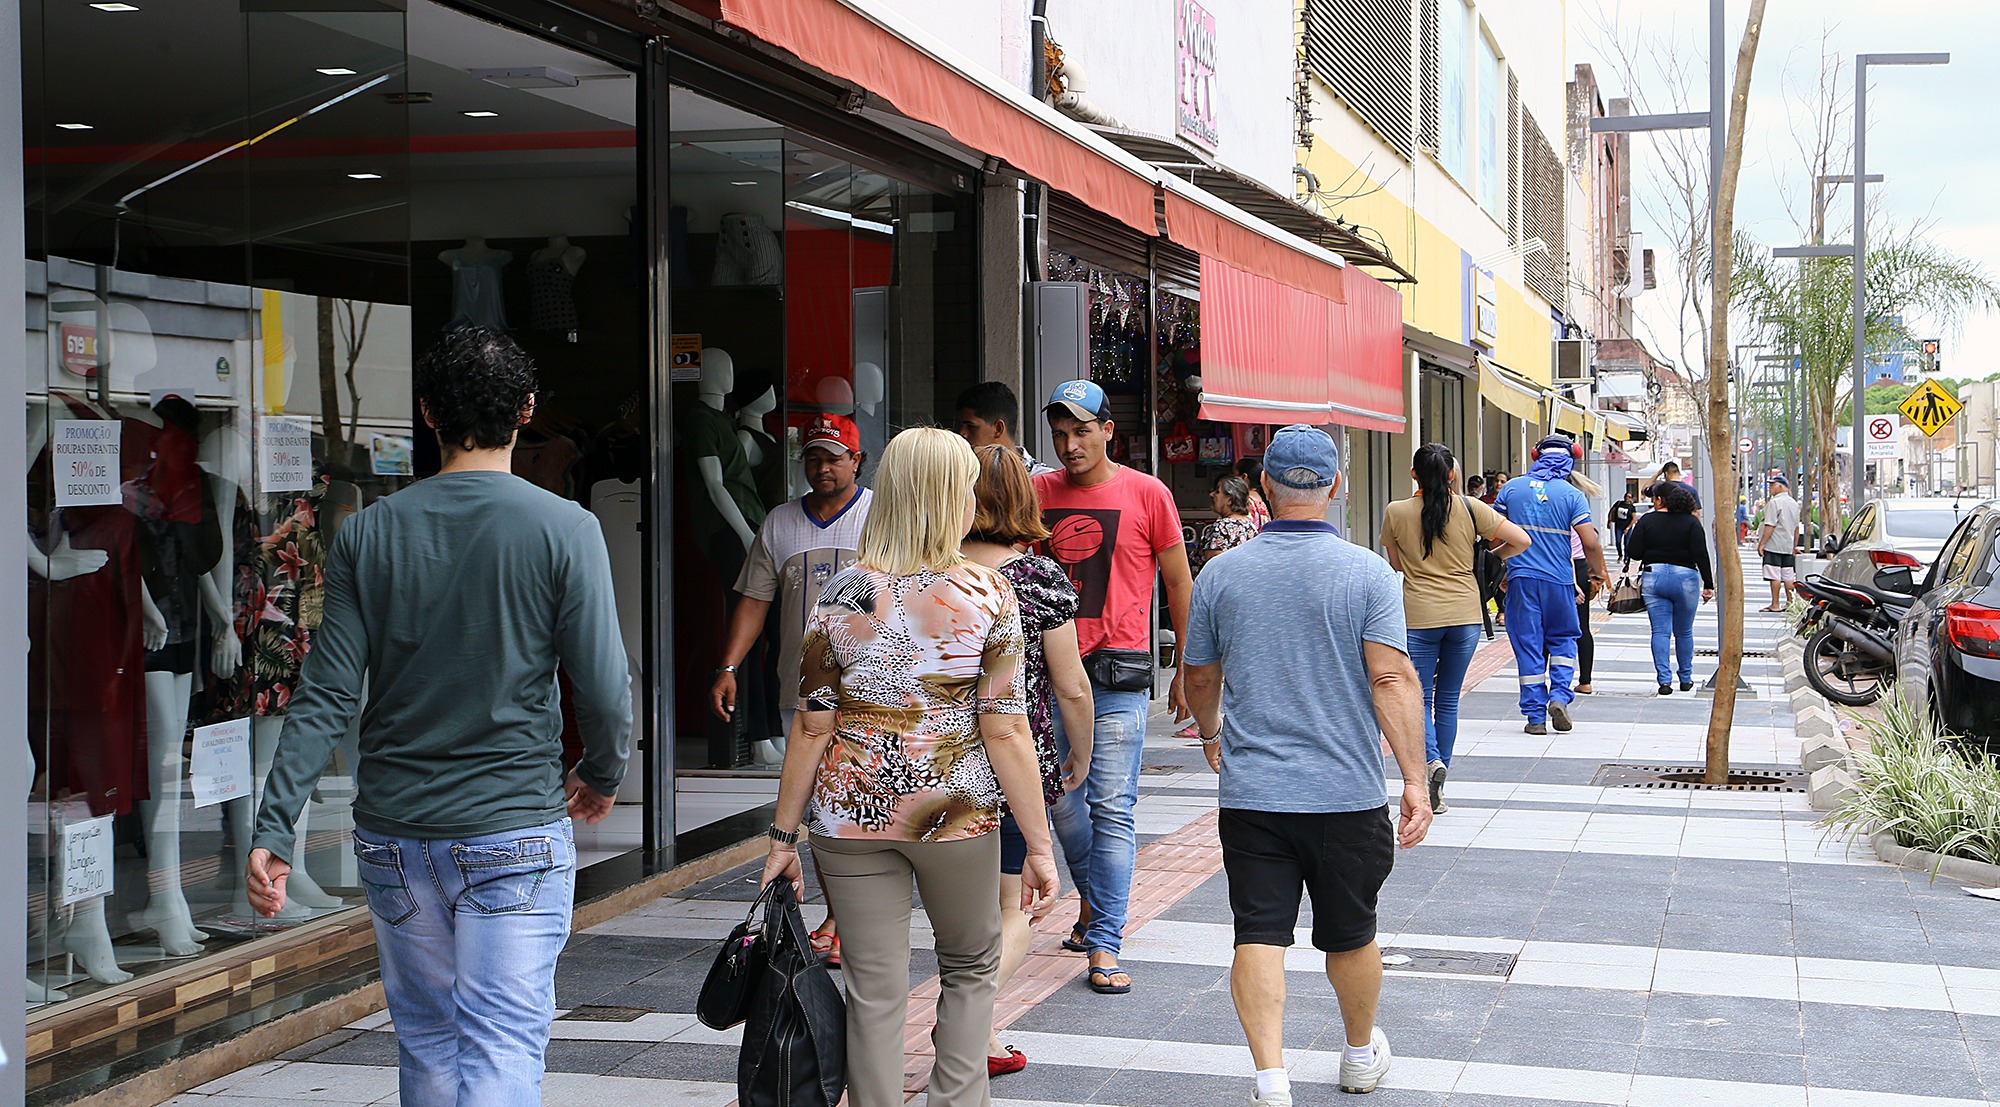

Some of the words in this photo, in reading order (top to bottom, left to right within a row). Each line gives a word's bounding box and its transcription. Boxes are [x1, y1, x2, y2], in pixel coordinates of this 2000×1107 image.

[65, 426, 111, 441] PROMOÇÃO
[263, 437, 284, 447] ROUPAS
[285, 437, 310, 447] INFANTIS
[56, 443, 86, 454] ROUPAS
[87, 443, 119, 455] INFANTIS
[273, 452, 291, 466] 50%
[291, 456, 300, 466] DE
[71, 461, 93, 477] 50%
[95, 465, 106, 477] DE
[270, 472, 304, 483] DESCONTO
[67, 484, 111, 496] DESCONTO
